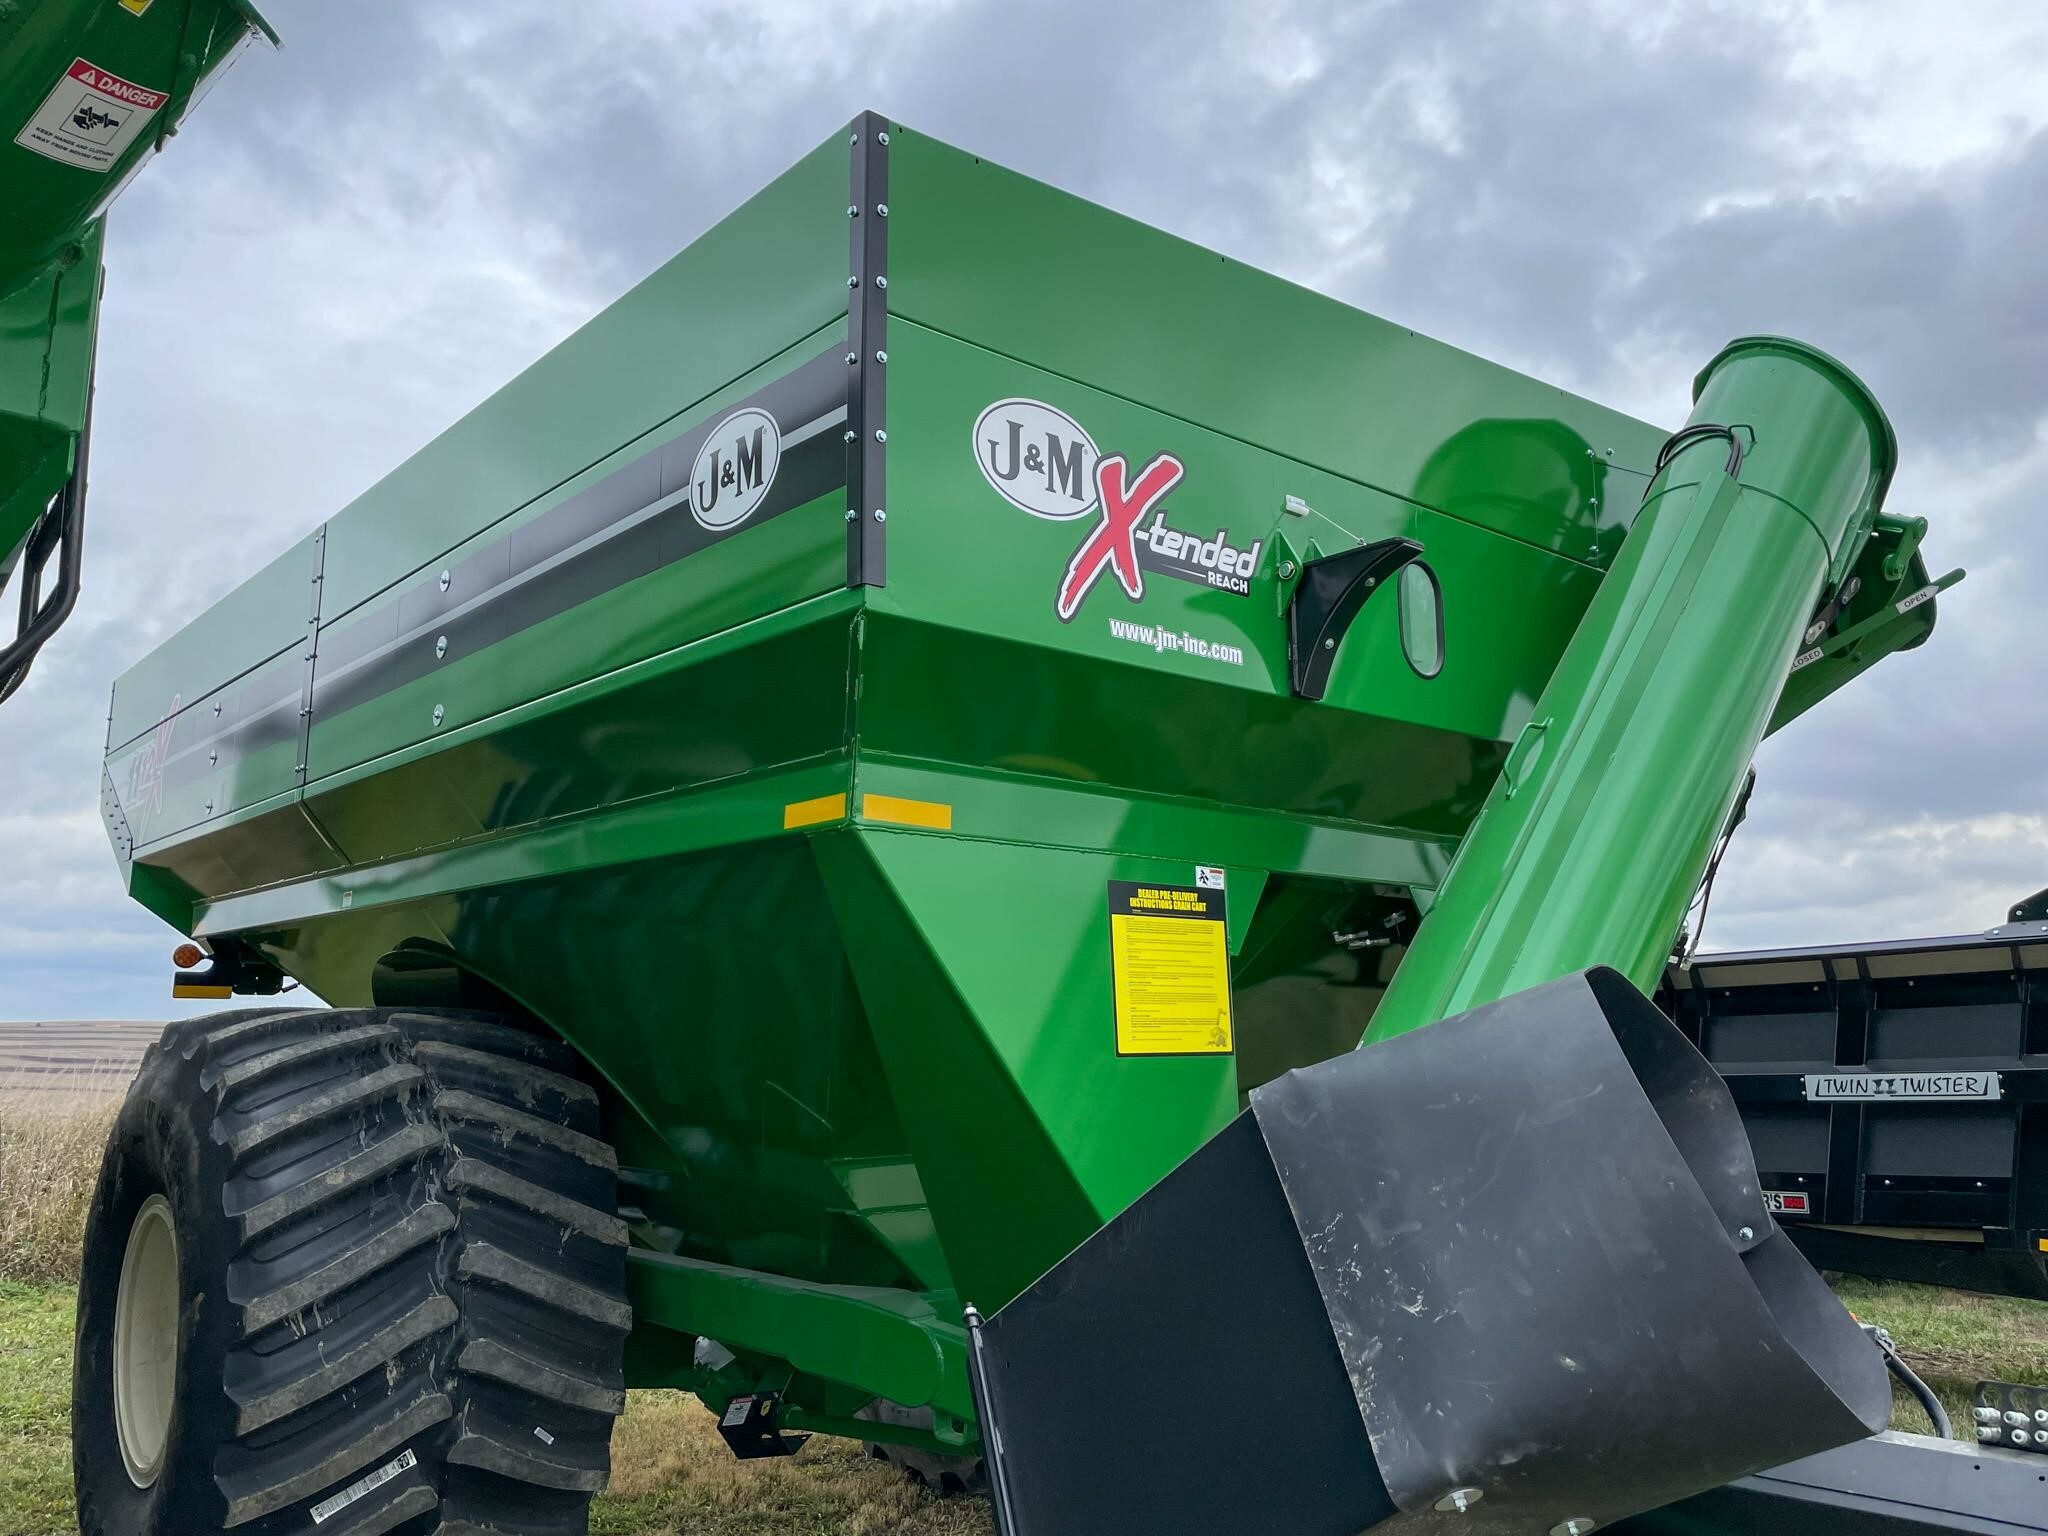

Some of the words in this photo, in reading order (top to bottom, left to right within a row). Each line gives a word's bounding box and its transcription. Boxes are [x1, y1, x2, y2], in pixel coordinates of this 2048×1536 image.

[98, 76, 158, 106] DANGER
[31, 133, 50, 144] AWAY
[50, 141, 68, 151] FROM
[69, 148, 91, 159] MOVING
[36, 127, 53, 137] KEEP
[53, 135, 75, 146] HANDS
[698, 425, 764, 512] J&M
[987, 419, 1085, 502] J&M
[1207, 571, 1249, 594] REACH
[1904, 591, 1928, 608] OPEN
[1109, 618, 1243, 665] www.jm-inc.com
[1129, 897, 1173, 909] INSTRUCTIONS
[1173, 900, 1191, 911] GRAIN
[1191, 902, 1207, 912] CART
[1137, 888, 1160, 899] DEALER
[1160, 890, 1198, 902] PRE-DELIVERY
[1823, 1078, 1868, 1094] TWIN
[1902, 1077, 1979, 1094] TWISTER
